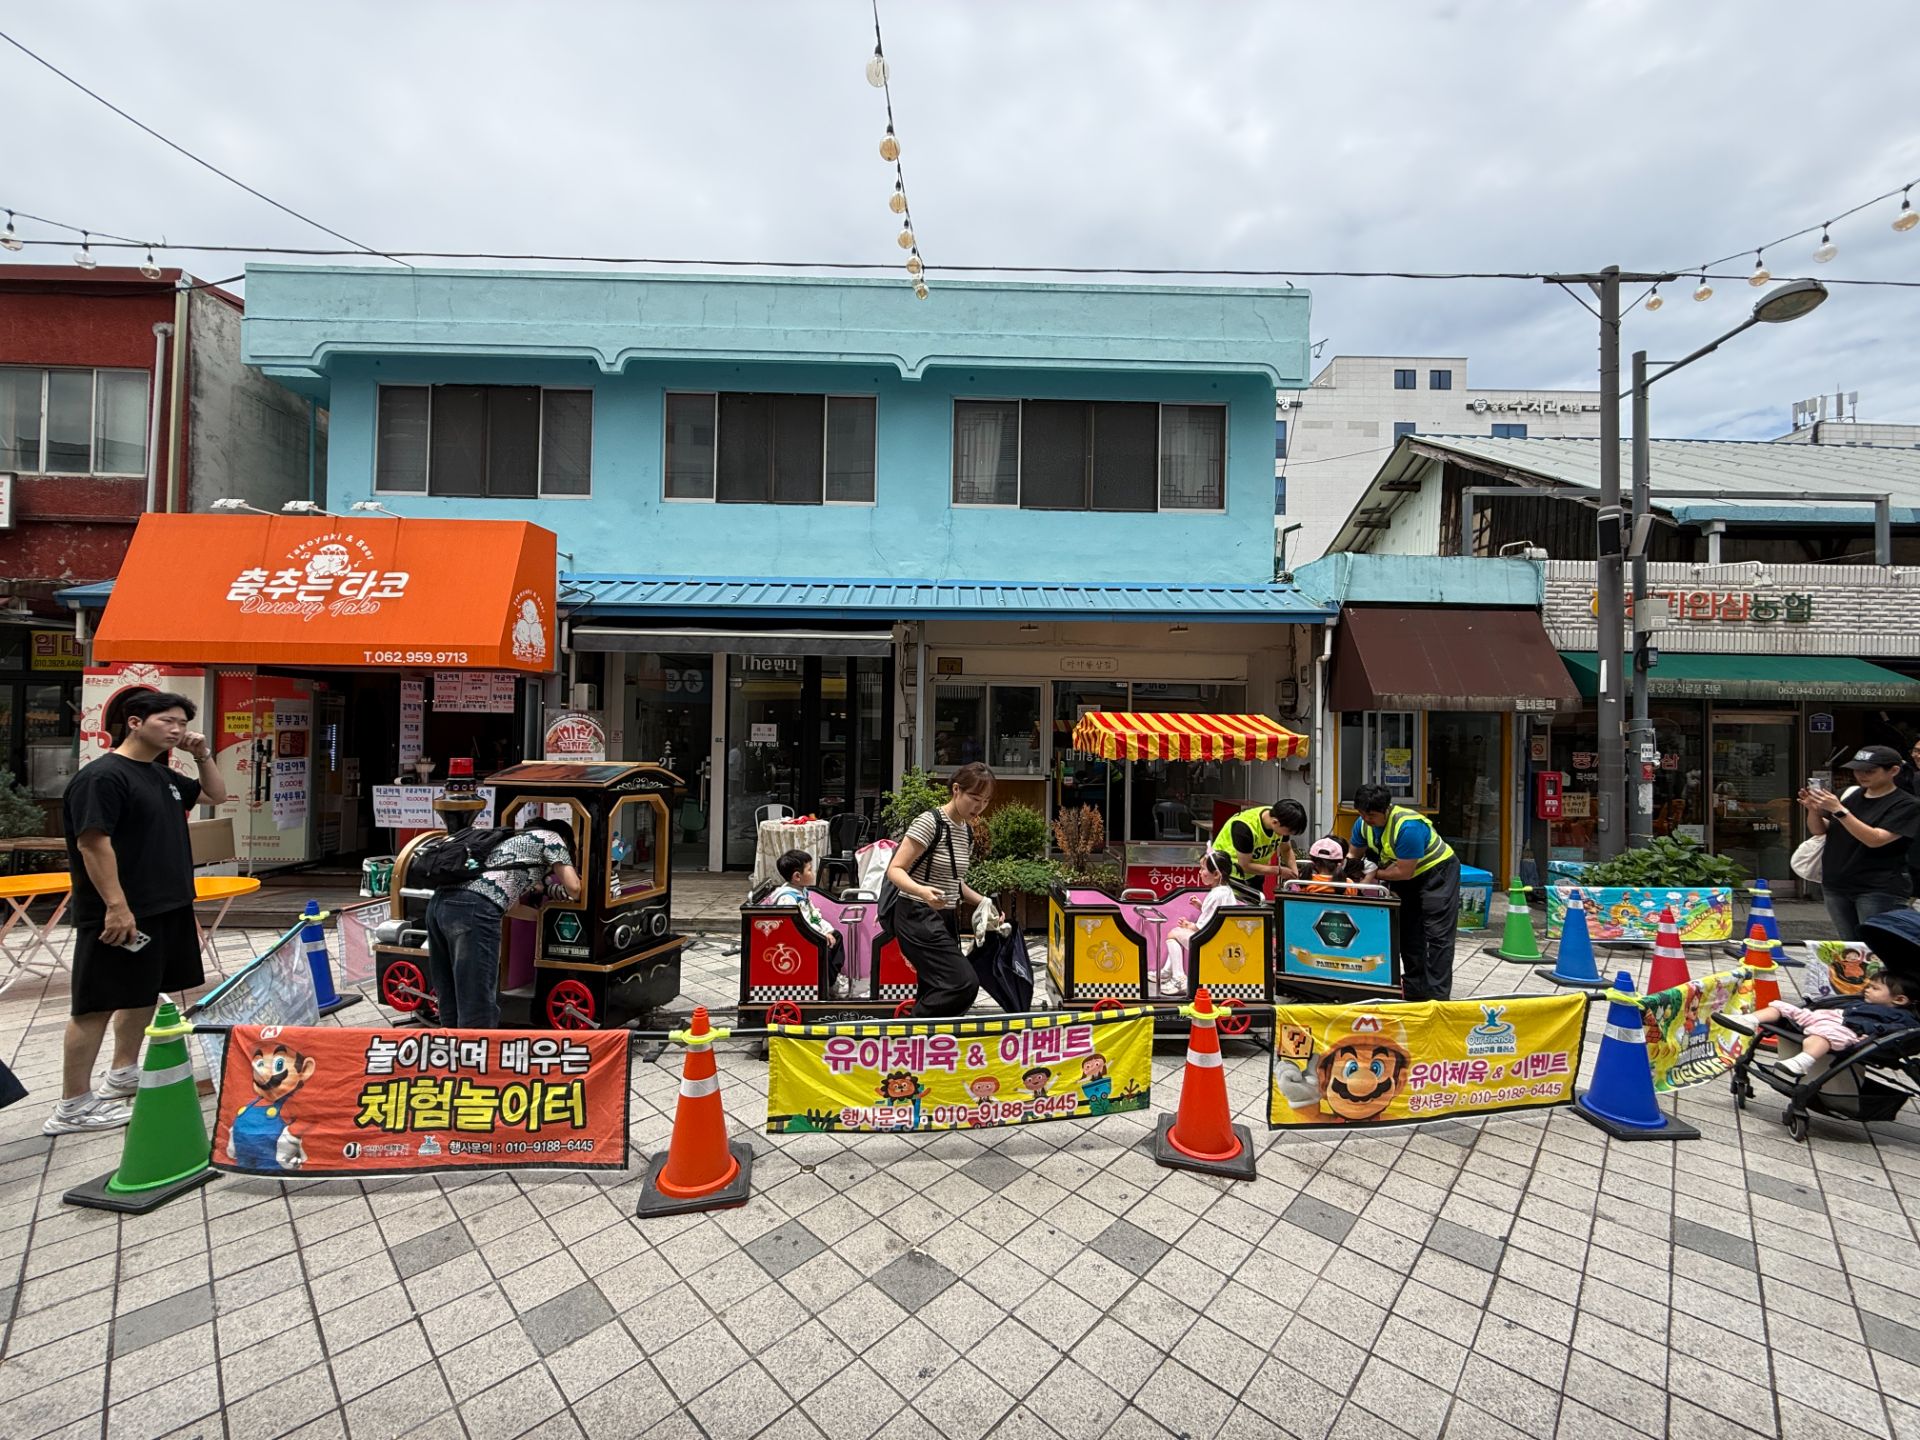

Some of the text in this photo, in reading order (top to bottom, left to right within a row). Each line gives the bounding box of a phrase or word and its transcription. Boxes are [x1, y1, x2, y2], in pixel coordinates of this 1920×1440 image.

[286, 532, 375, 561] Takoyaki & Beer
[226, 567, 410, 602] 춤추는 타코
[240, 594, 381, 622] Dancing Tako
[364, 651, 468, 664] T.062.959.9713
[276, 714, 308, 726] 두부김치
[1817, 722, 1827, 730] 12
[658, 757, 677, 771] 2F
[1148, 867, 1200, 891] 송정역시
[1227, 948, 1241, 958] 15
[366, 1036, 592, 1075] 놀이하며 배우는
[823, 1026, 1094, 1073] 유아체육 & 이벤트
[1408, 1052, 1569, 1089] 유아체육 & 이벤트
[354, 1078, 586, 1134] 체험놀이터
[841, 1106, 913, 1127] 행사문의
[933, 1095, 1077, 1123] 010-9188-6445
[1409, 1093, 1457, 1112] 행사문의
[1468, 1083, 1563, 1104] 010-9188-6445
[449, 1139, 494, 1155] 행사문의
[504, 1138, 594, 1154] 010-9188-6445
